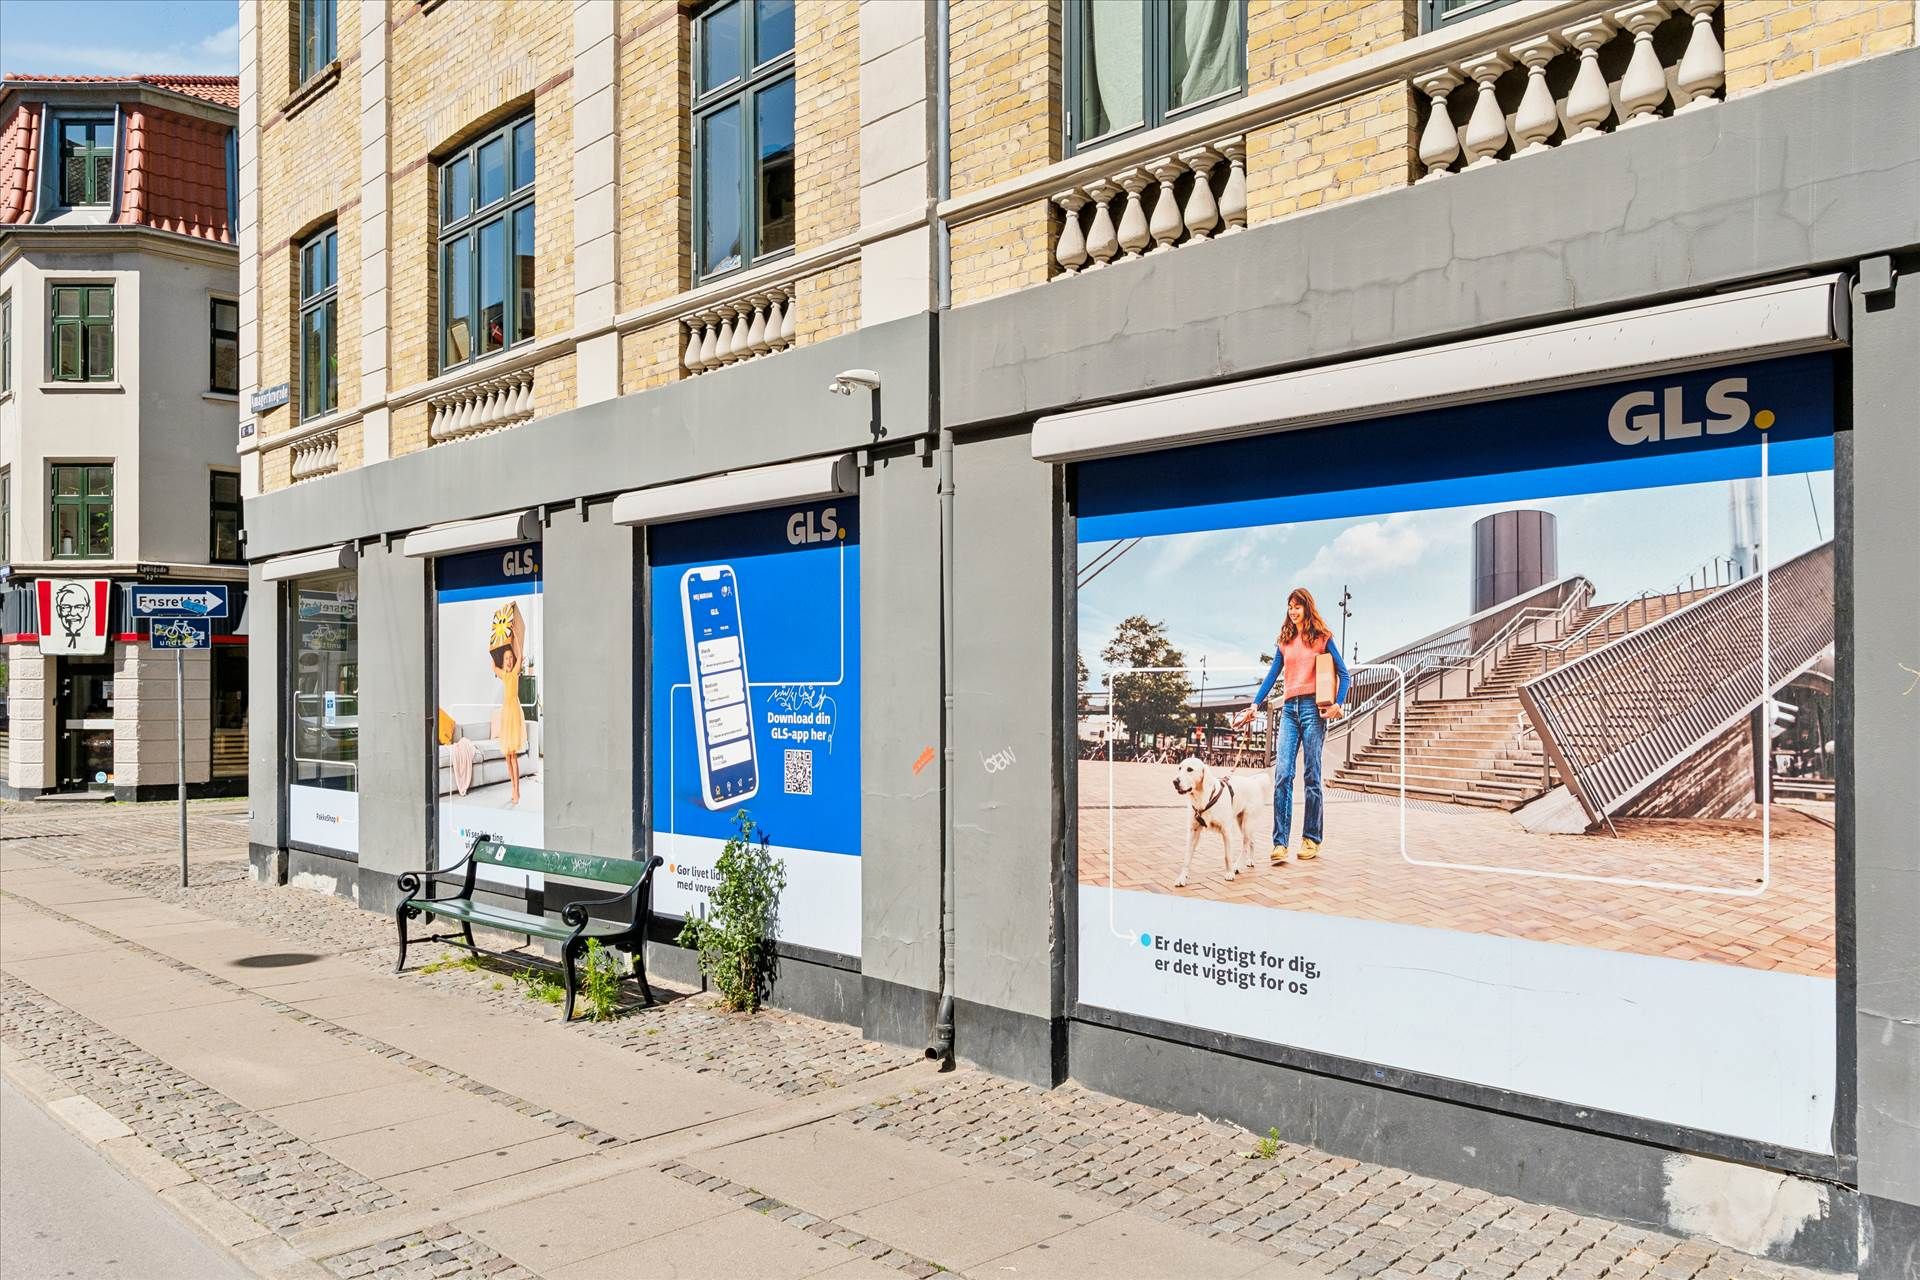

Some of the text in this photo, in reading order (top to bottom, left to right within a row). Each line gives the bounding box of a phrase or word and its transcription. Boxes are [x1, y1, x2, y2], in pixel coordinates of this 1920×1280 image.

[160, 638, 203, 646] undtt
[767, 712, 831, 725] Download din
[771, 727, 827, 743] GLS-app her
[691, 866, 709, 879] livet
[677, 881, 693, 891] med
[1154, 935, 1321, 979] Er det vigtigt for dig,
[1154, 958, 1308, 995] er det vigtigt for os
